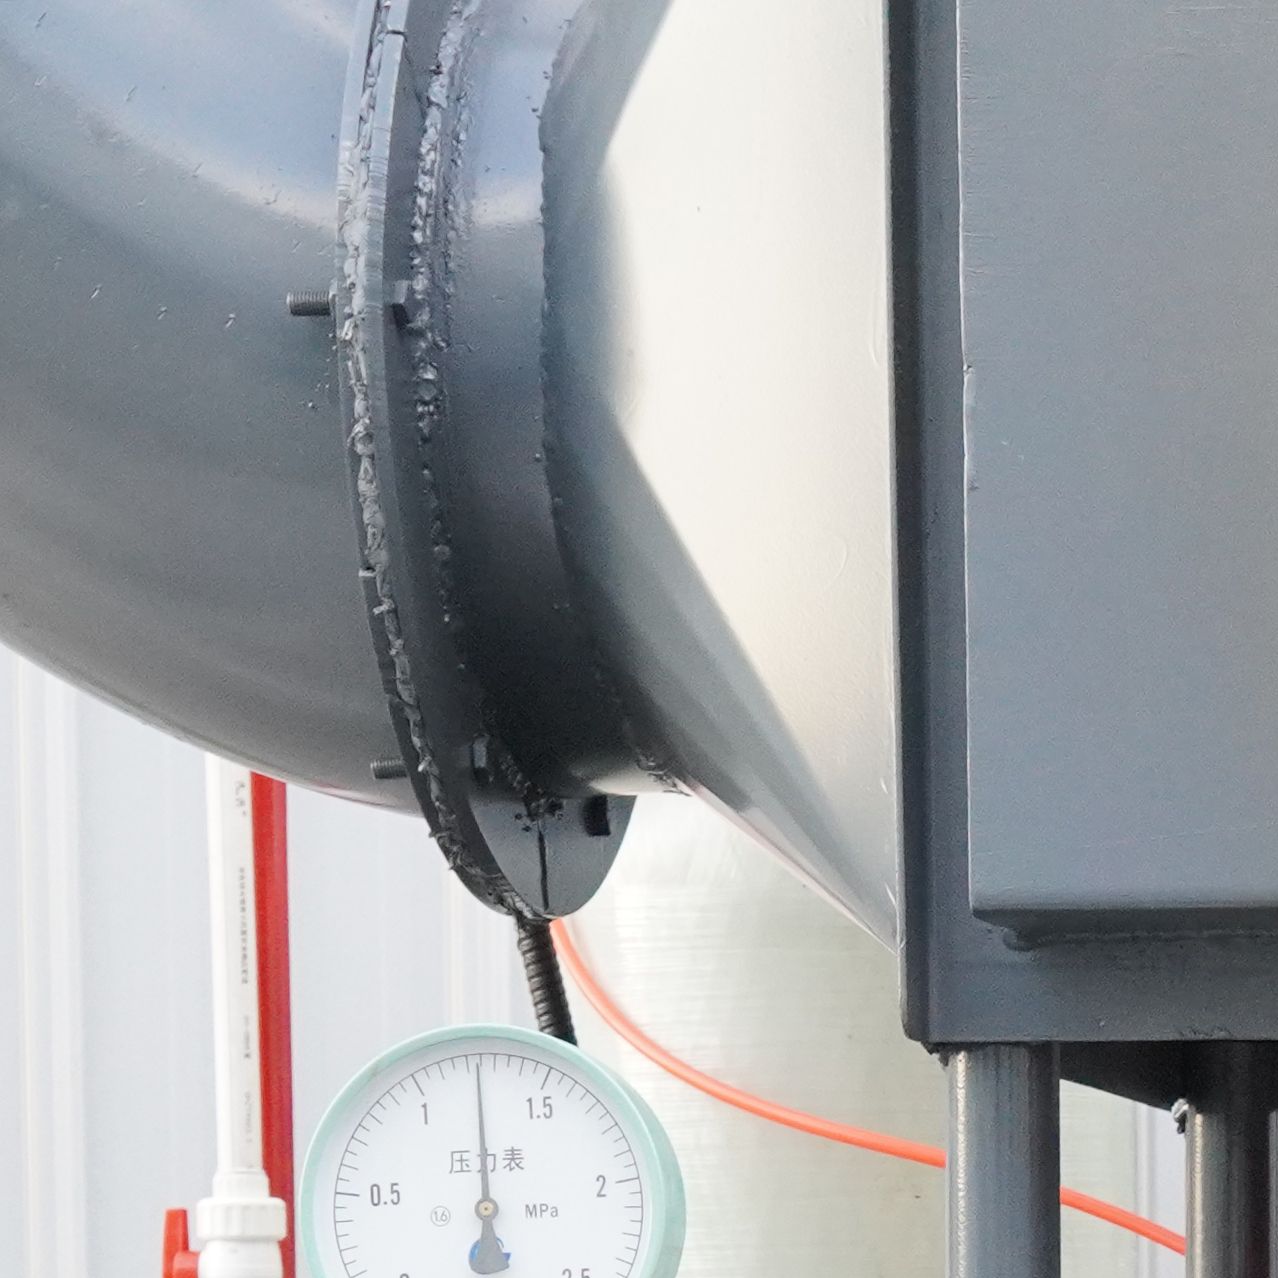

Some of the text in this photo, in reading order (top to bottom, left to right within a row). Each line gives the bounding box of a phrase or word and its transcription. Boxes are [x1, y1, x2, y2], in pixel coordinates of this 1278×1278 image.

[421, 1102, 429, 1125] 1
[526, 1096, 553, 1120] 1.5
[448, 1147, 526, 1175] 压力表
[370, 1183, 401, 1206] 0.5
[595, 1175, 607, 1198] 2
[525, 1204, 559, 1218] MPa
